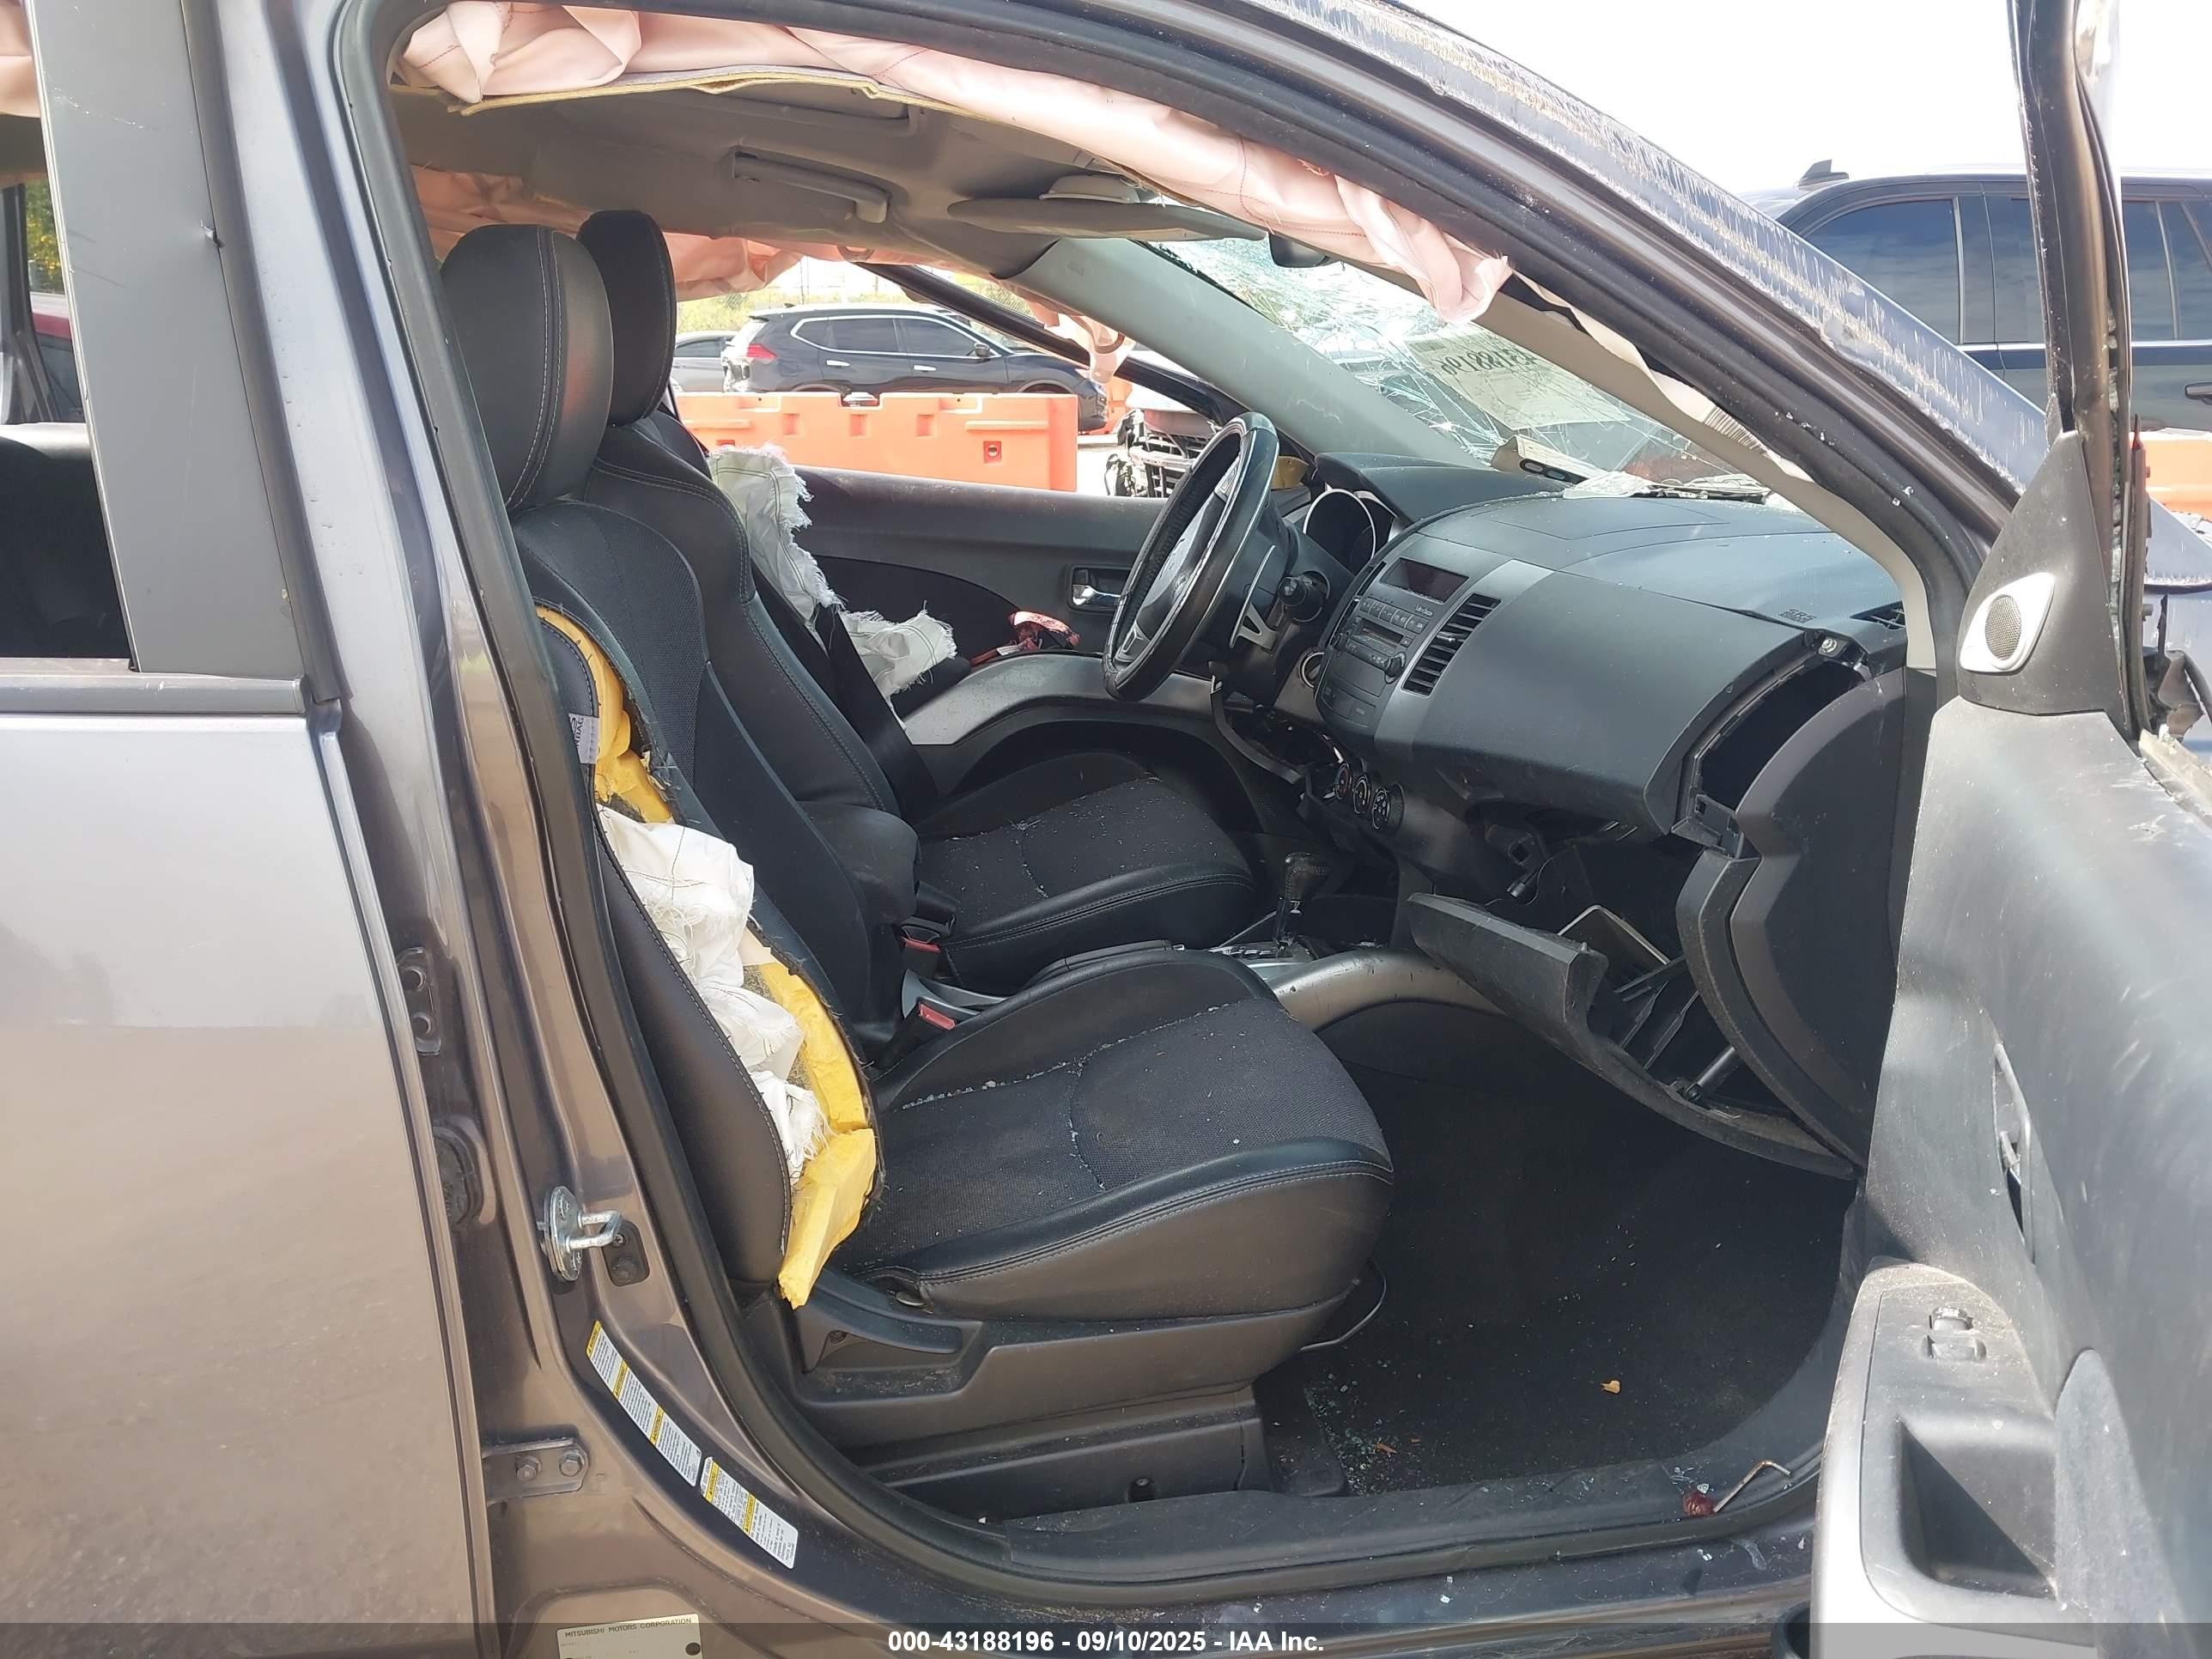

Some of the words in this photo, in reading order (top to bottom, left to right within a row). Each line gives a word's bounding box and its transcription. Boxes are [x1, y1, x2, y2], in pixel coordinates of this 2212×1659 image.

[564, 1628, 605, 1638] MITSUBISHI
[608, 1624, 637, 1633] MOTORS
[640, 1617, 692, 1630] CORPORATION
